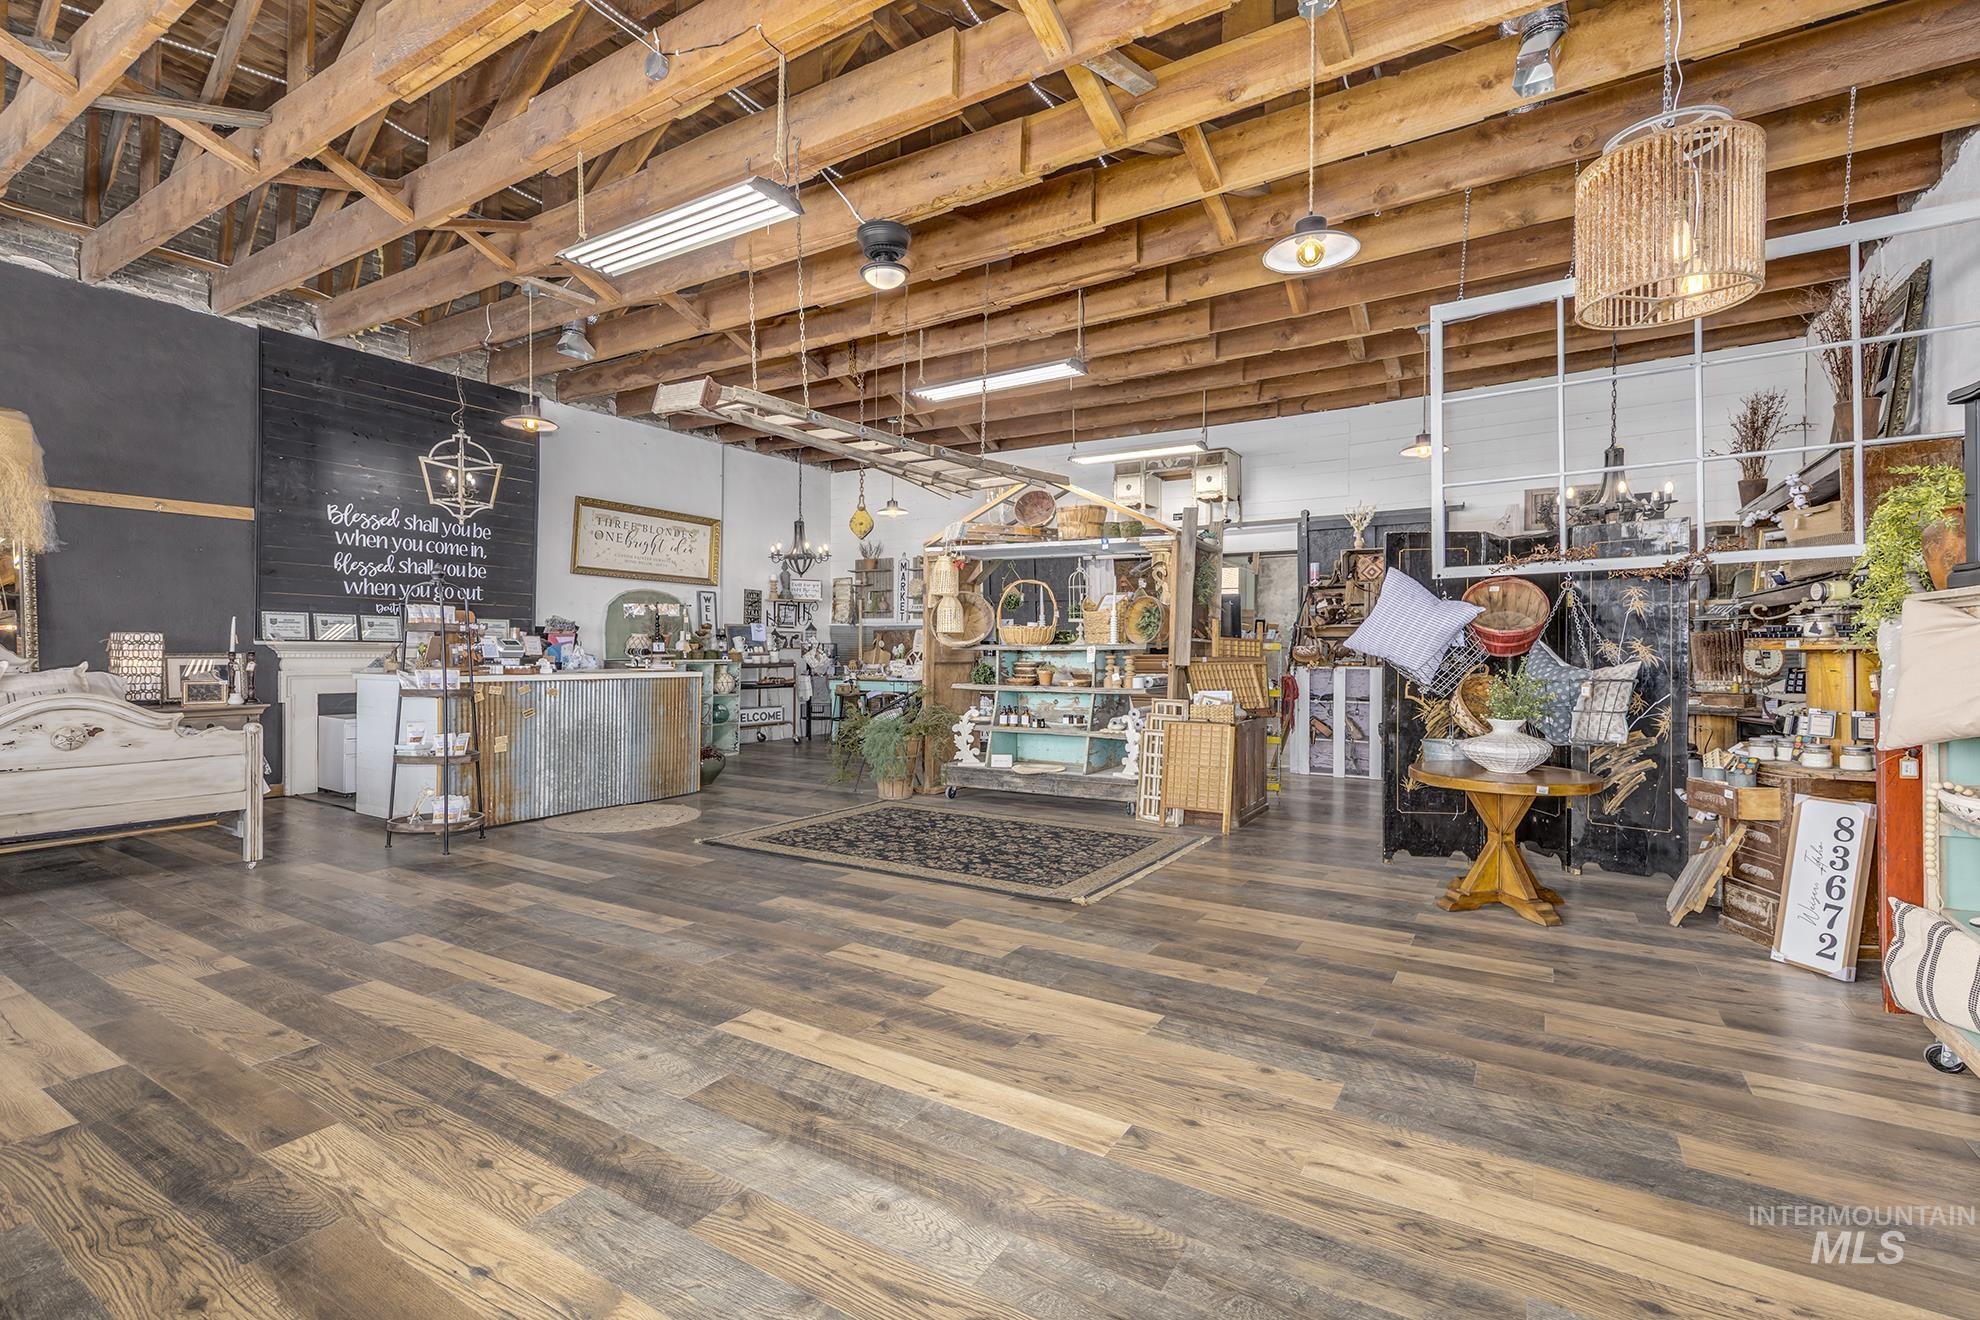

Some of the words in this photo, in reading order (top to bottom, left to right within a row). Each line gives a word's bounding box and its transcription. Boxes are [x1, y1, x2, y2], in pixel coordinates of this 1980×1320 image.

[327, 503, 400, 530] Blessed
[404, 514, 438, 533] shall
[441, 521, 470, 538] you
[473, 522, 491, 540] be
[596, 516, 637, 531] THREE
[642, 524, 694, 539] BLONDES
[334, 529, 388, 549] when
[391, 537, 423, 553] you
[426, 540, 468, 555] come
[470, 542, 487, 559] in,
[594, 530, 624, 543] ONE
[625, 529, 665, 555] bright
[670, 537, 695, 555] idea
[334, 551, 395, 577] blessed
[399, 557, 434, 575] shall
[468, 562, 487, 578] be
[343, 578, 396, 596] when
[399, 583, 430, 600] you
[434, 585, 454, 602] go
[457, 585, 484, 600] out
[703, 596, 712, 621] WEL
[740, 711, 782, 722] ELCOME
[1815, 816, 1855, 961] 83672
